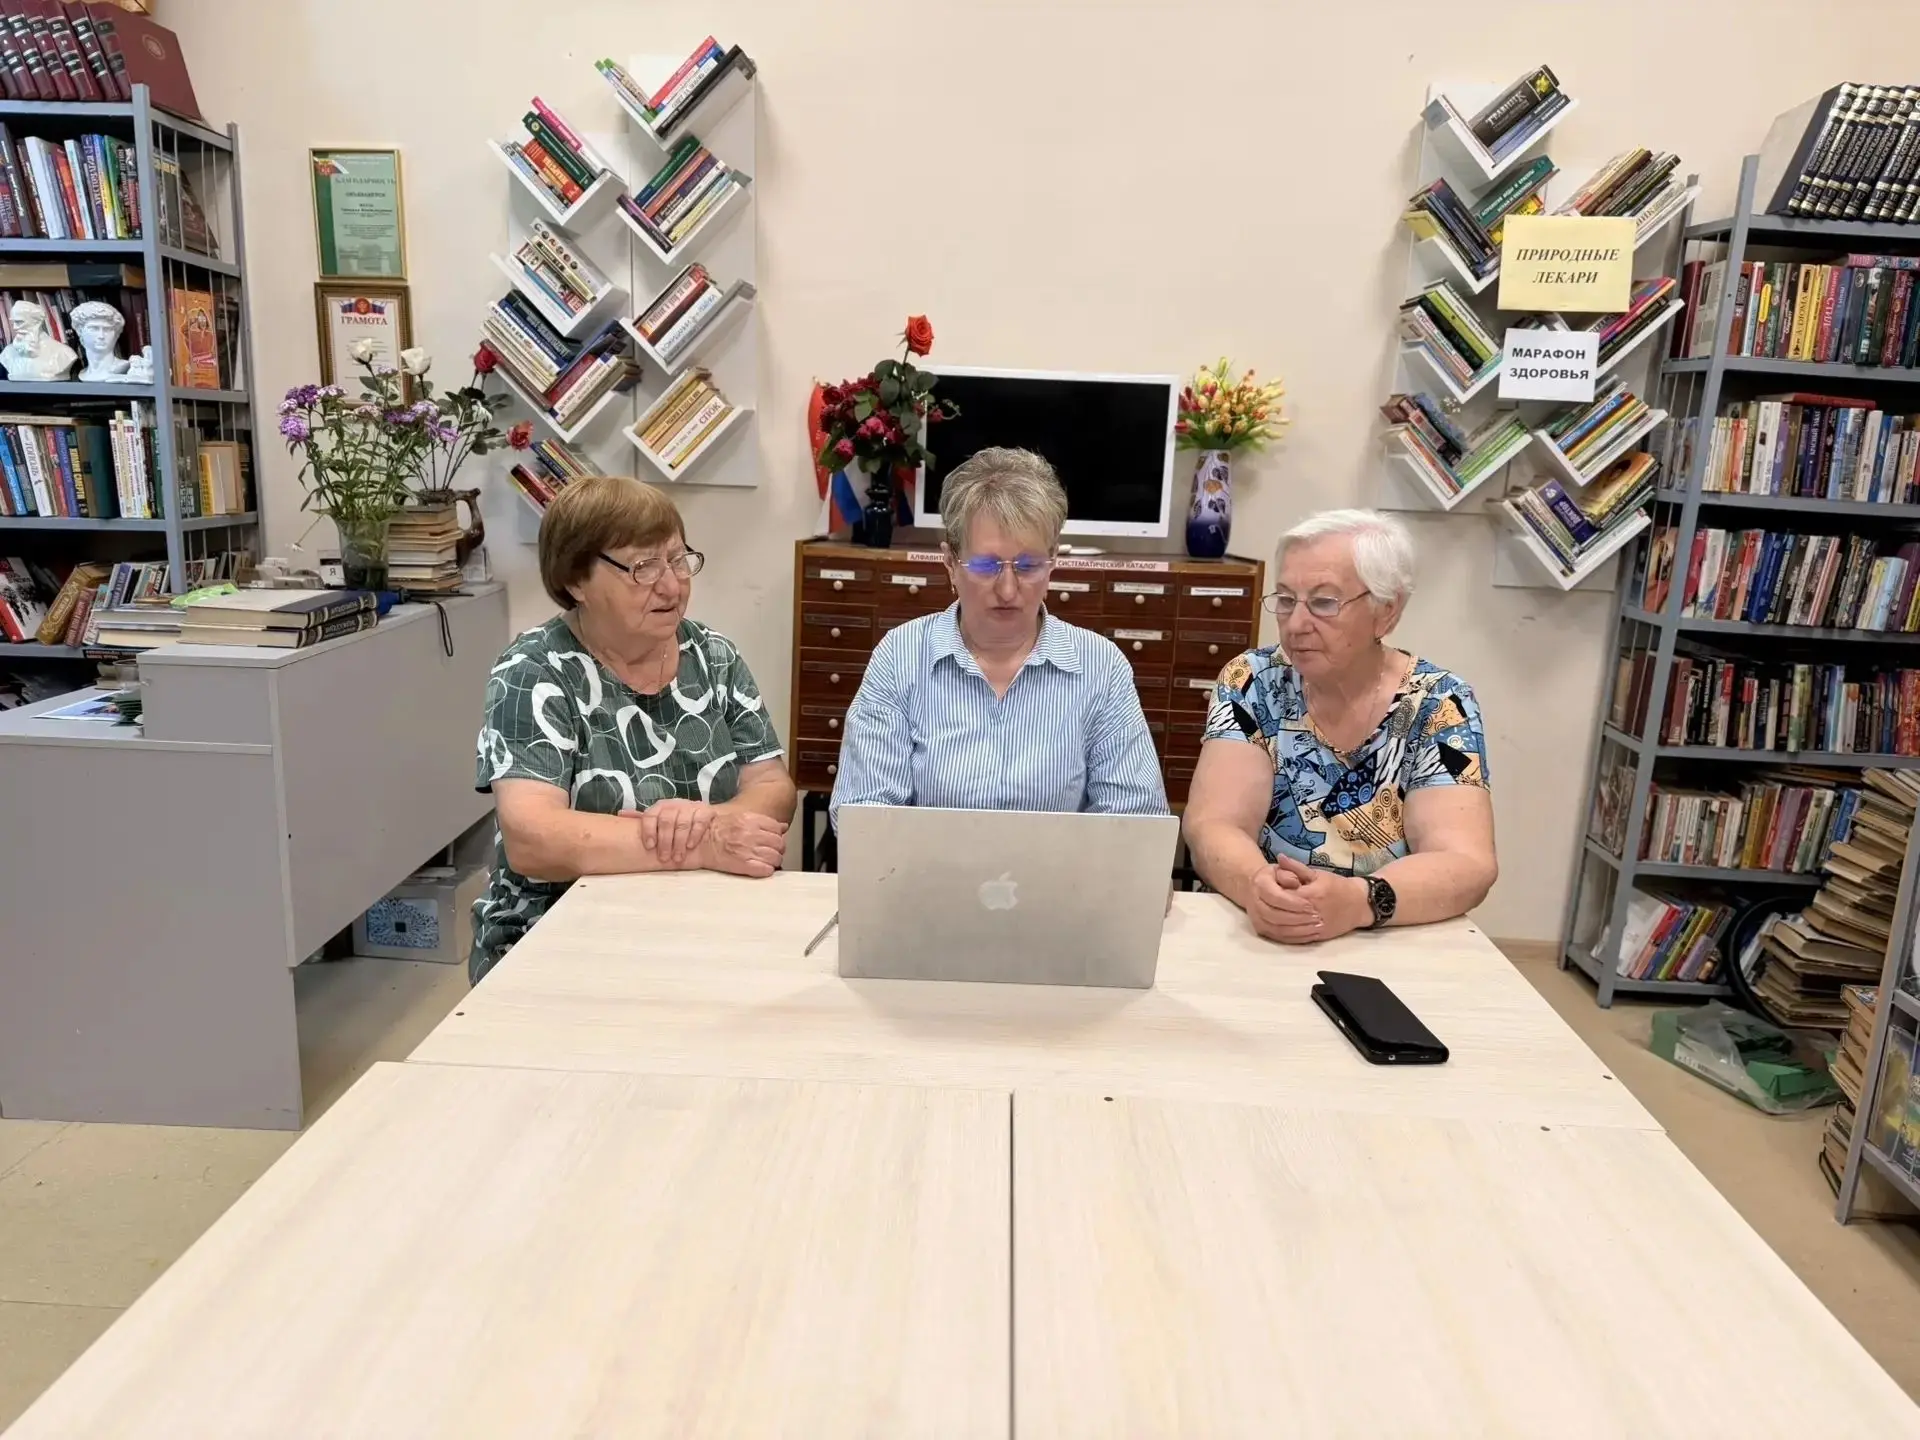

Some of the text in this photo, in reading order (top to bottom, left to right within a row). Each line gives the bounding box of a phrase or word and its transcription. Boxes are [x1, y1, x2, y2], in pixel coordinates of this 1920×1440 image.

[1516, 248, 1620, 262] ПРИРОДНЫЕ
[1532, 270, 1599, 285] ЛЕКАРИ
[341, 316, 388, 325] ГРАМОТА
[1511, 347, 1586, 360] МАРАФОН
[1509, 368, 1589, 380] ЗДОРОВЬЯ
[698, 401, 721, 425] СПОК
[1558, 498, 1581, 524] ДОКТОР
[329, 567, 335, 575] Я
